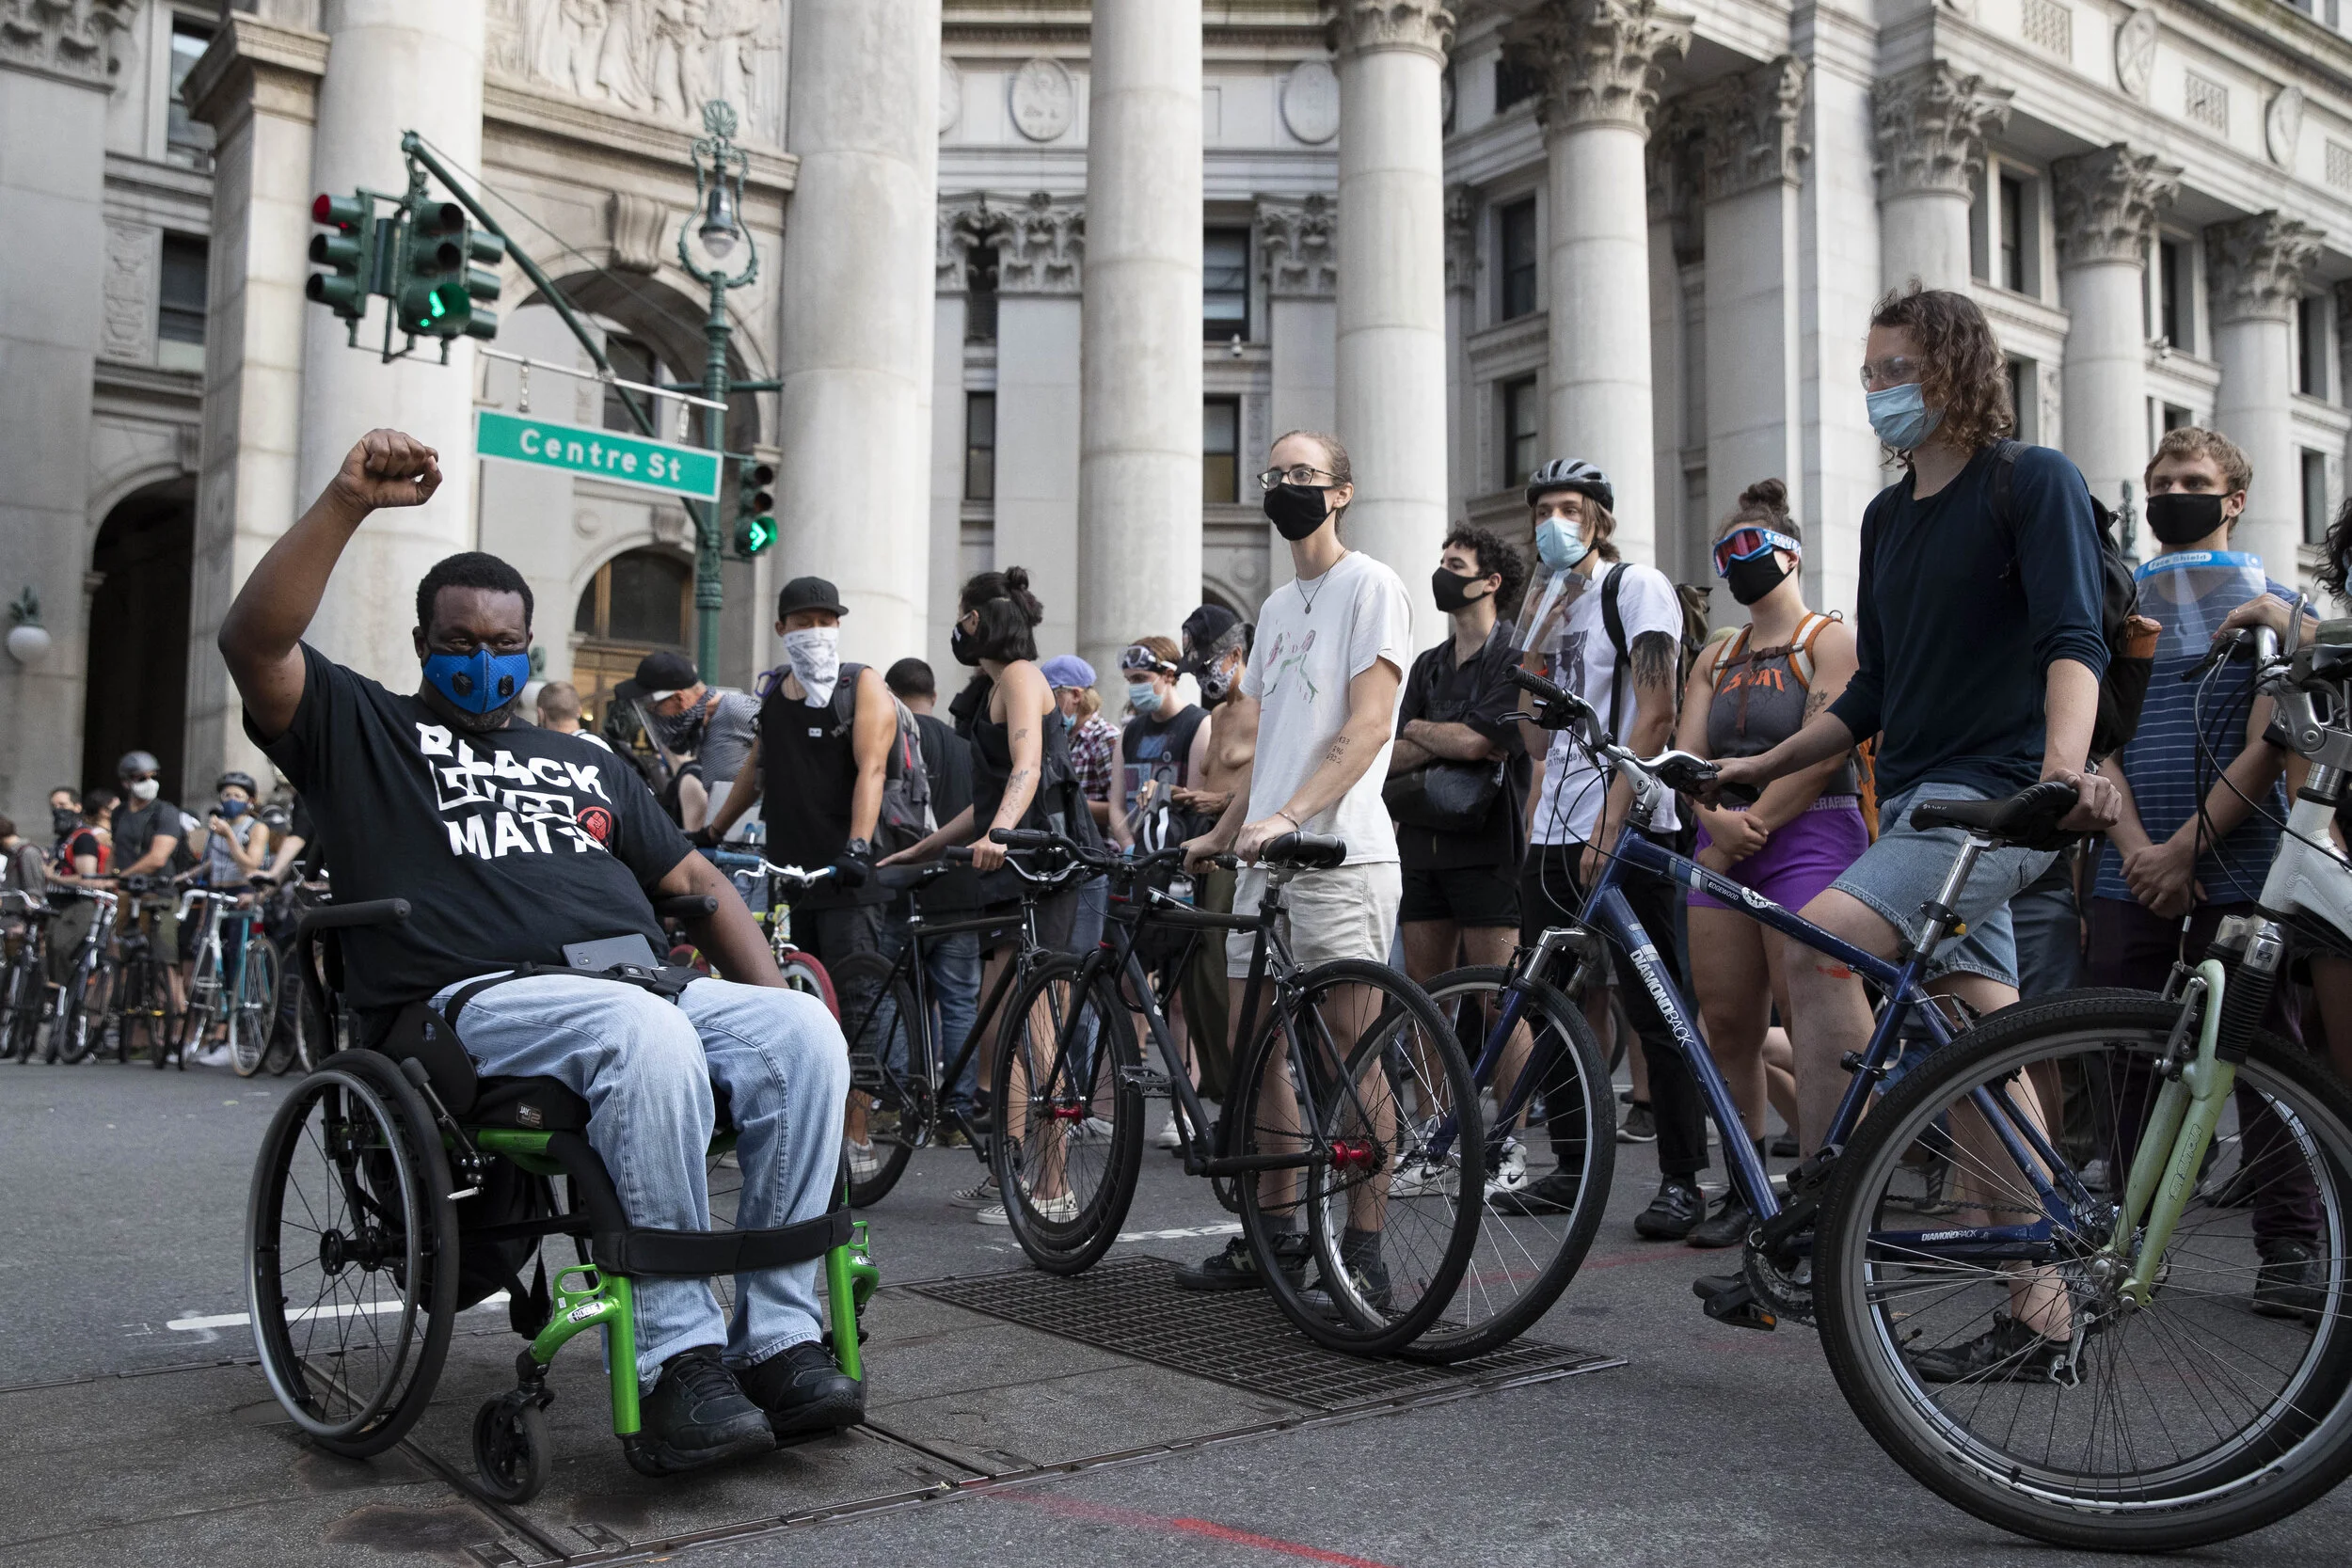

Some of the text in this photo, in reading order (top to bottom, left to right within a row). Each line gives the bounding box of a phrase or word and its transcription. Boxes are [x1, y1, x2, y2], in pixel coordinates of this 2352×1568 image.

[519, 428, 682, 483] Centre St
[415, 721, 612, 805] BLACK
[1708, 880, 1740, 901] EDGEWOOD
[1629, 948, 1695, 1049] DIAMONDBACK
[519, 1105, 532, 1117] JAY
